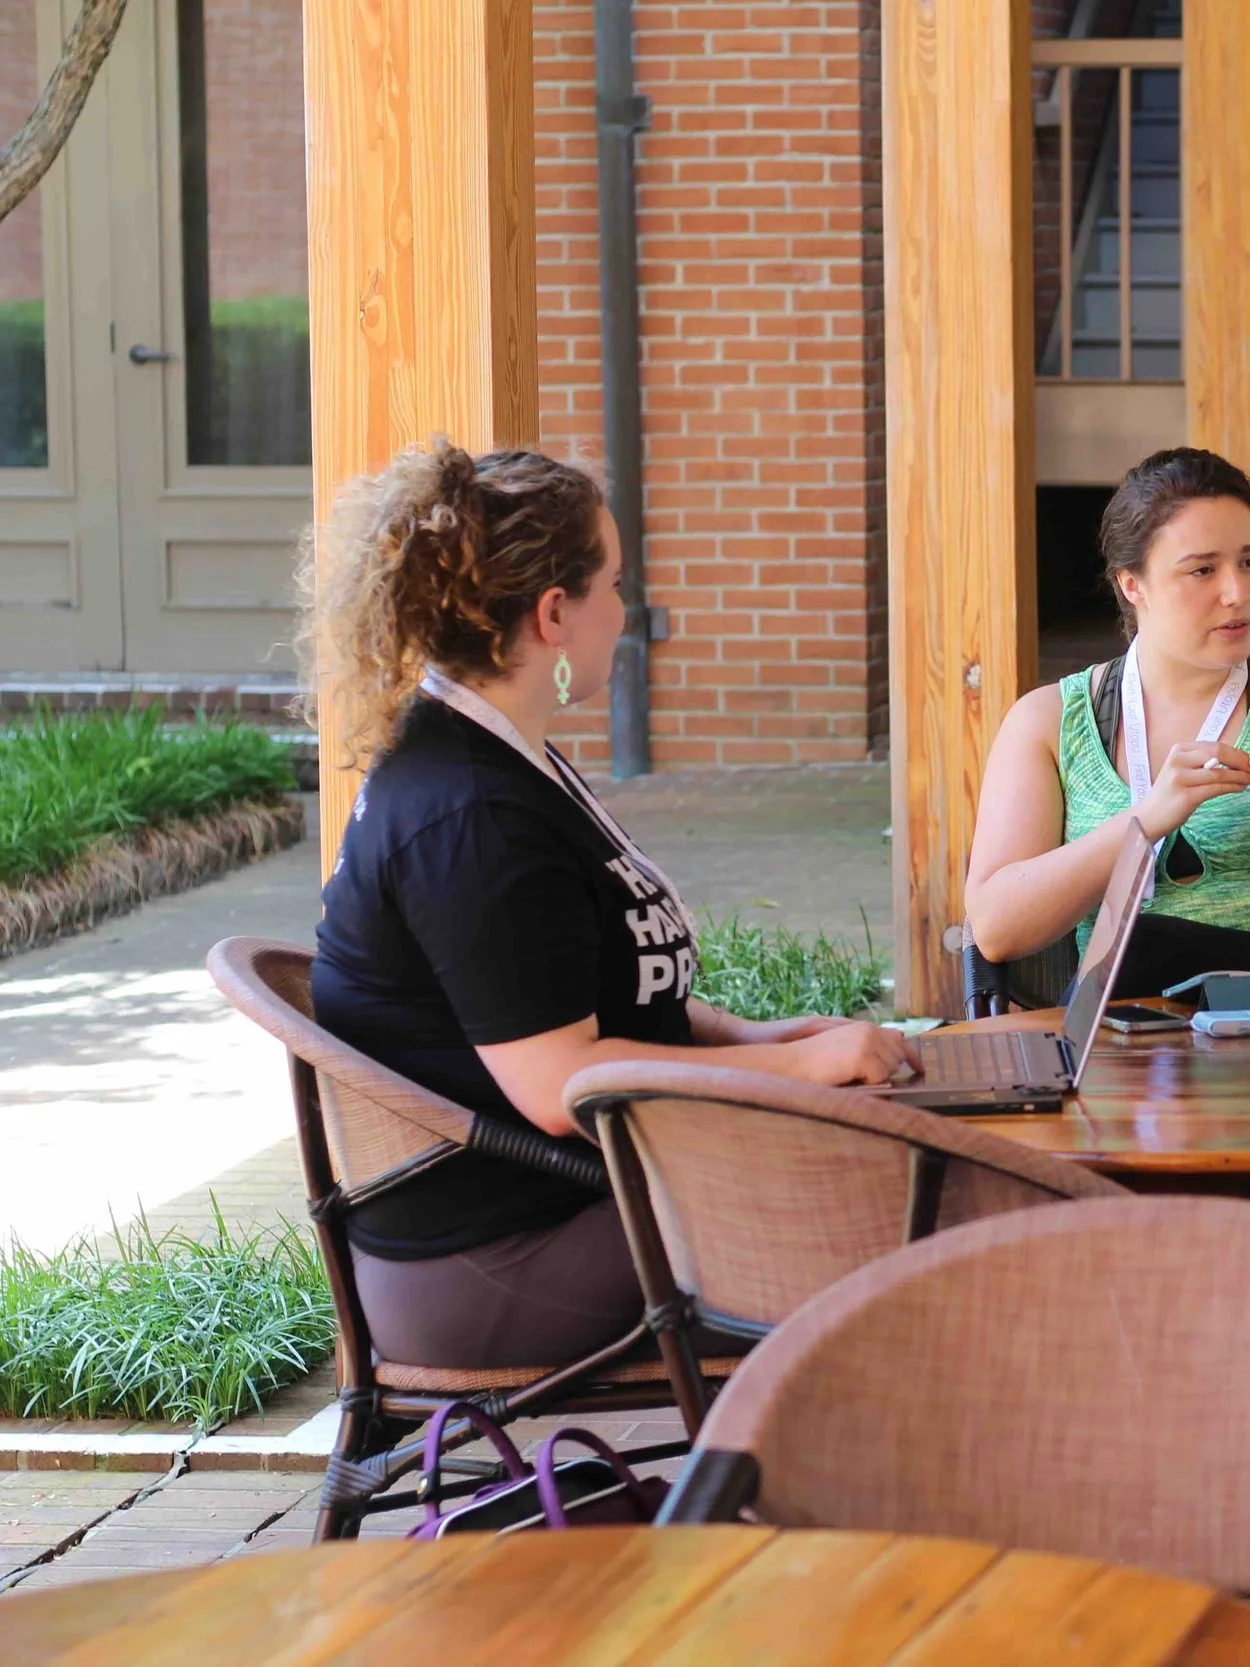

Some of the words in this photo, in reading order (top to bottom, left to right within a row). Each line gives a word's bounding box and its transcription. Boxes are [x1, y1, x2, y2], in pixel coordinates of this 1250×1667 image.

[1205, 716, 1221, 737] Your
[1216, 682, 1240, 714] Utopia
[1137, 782, 1148, 801] You
